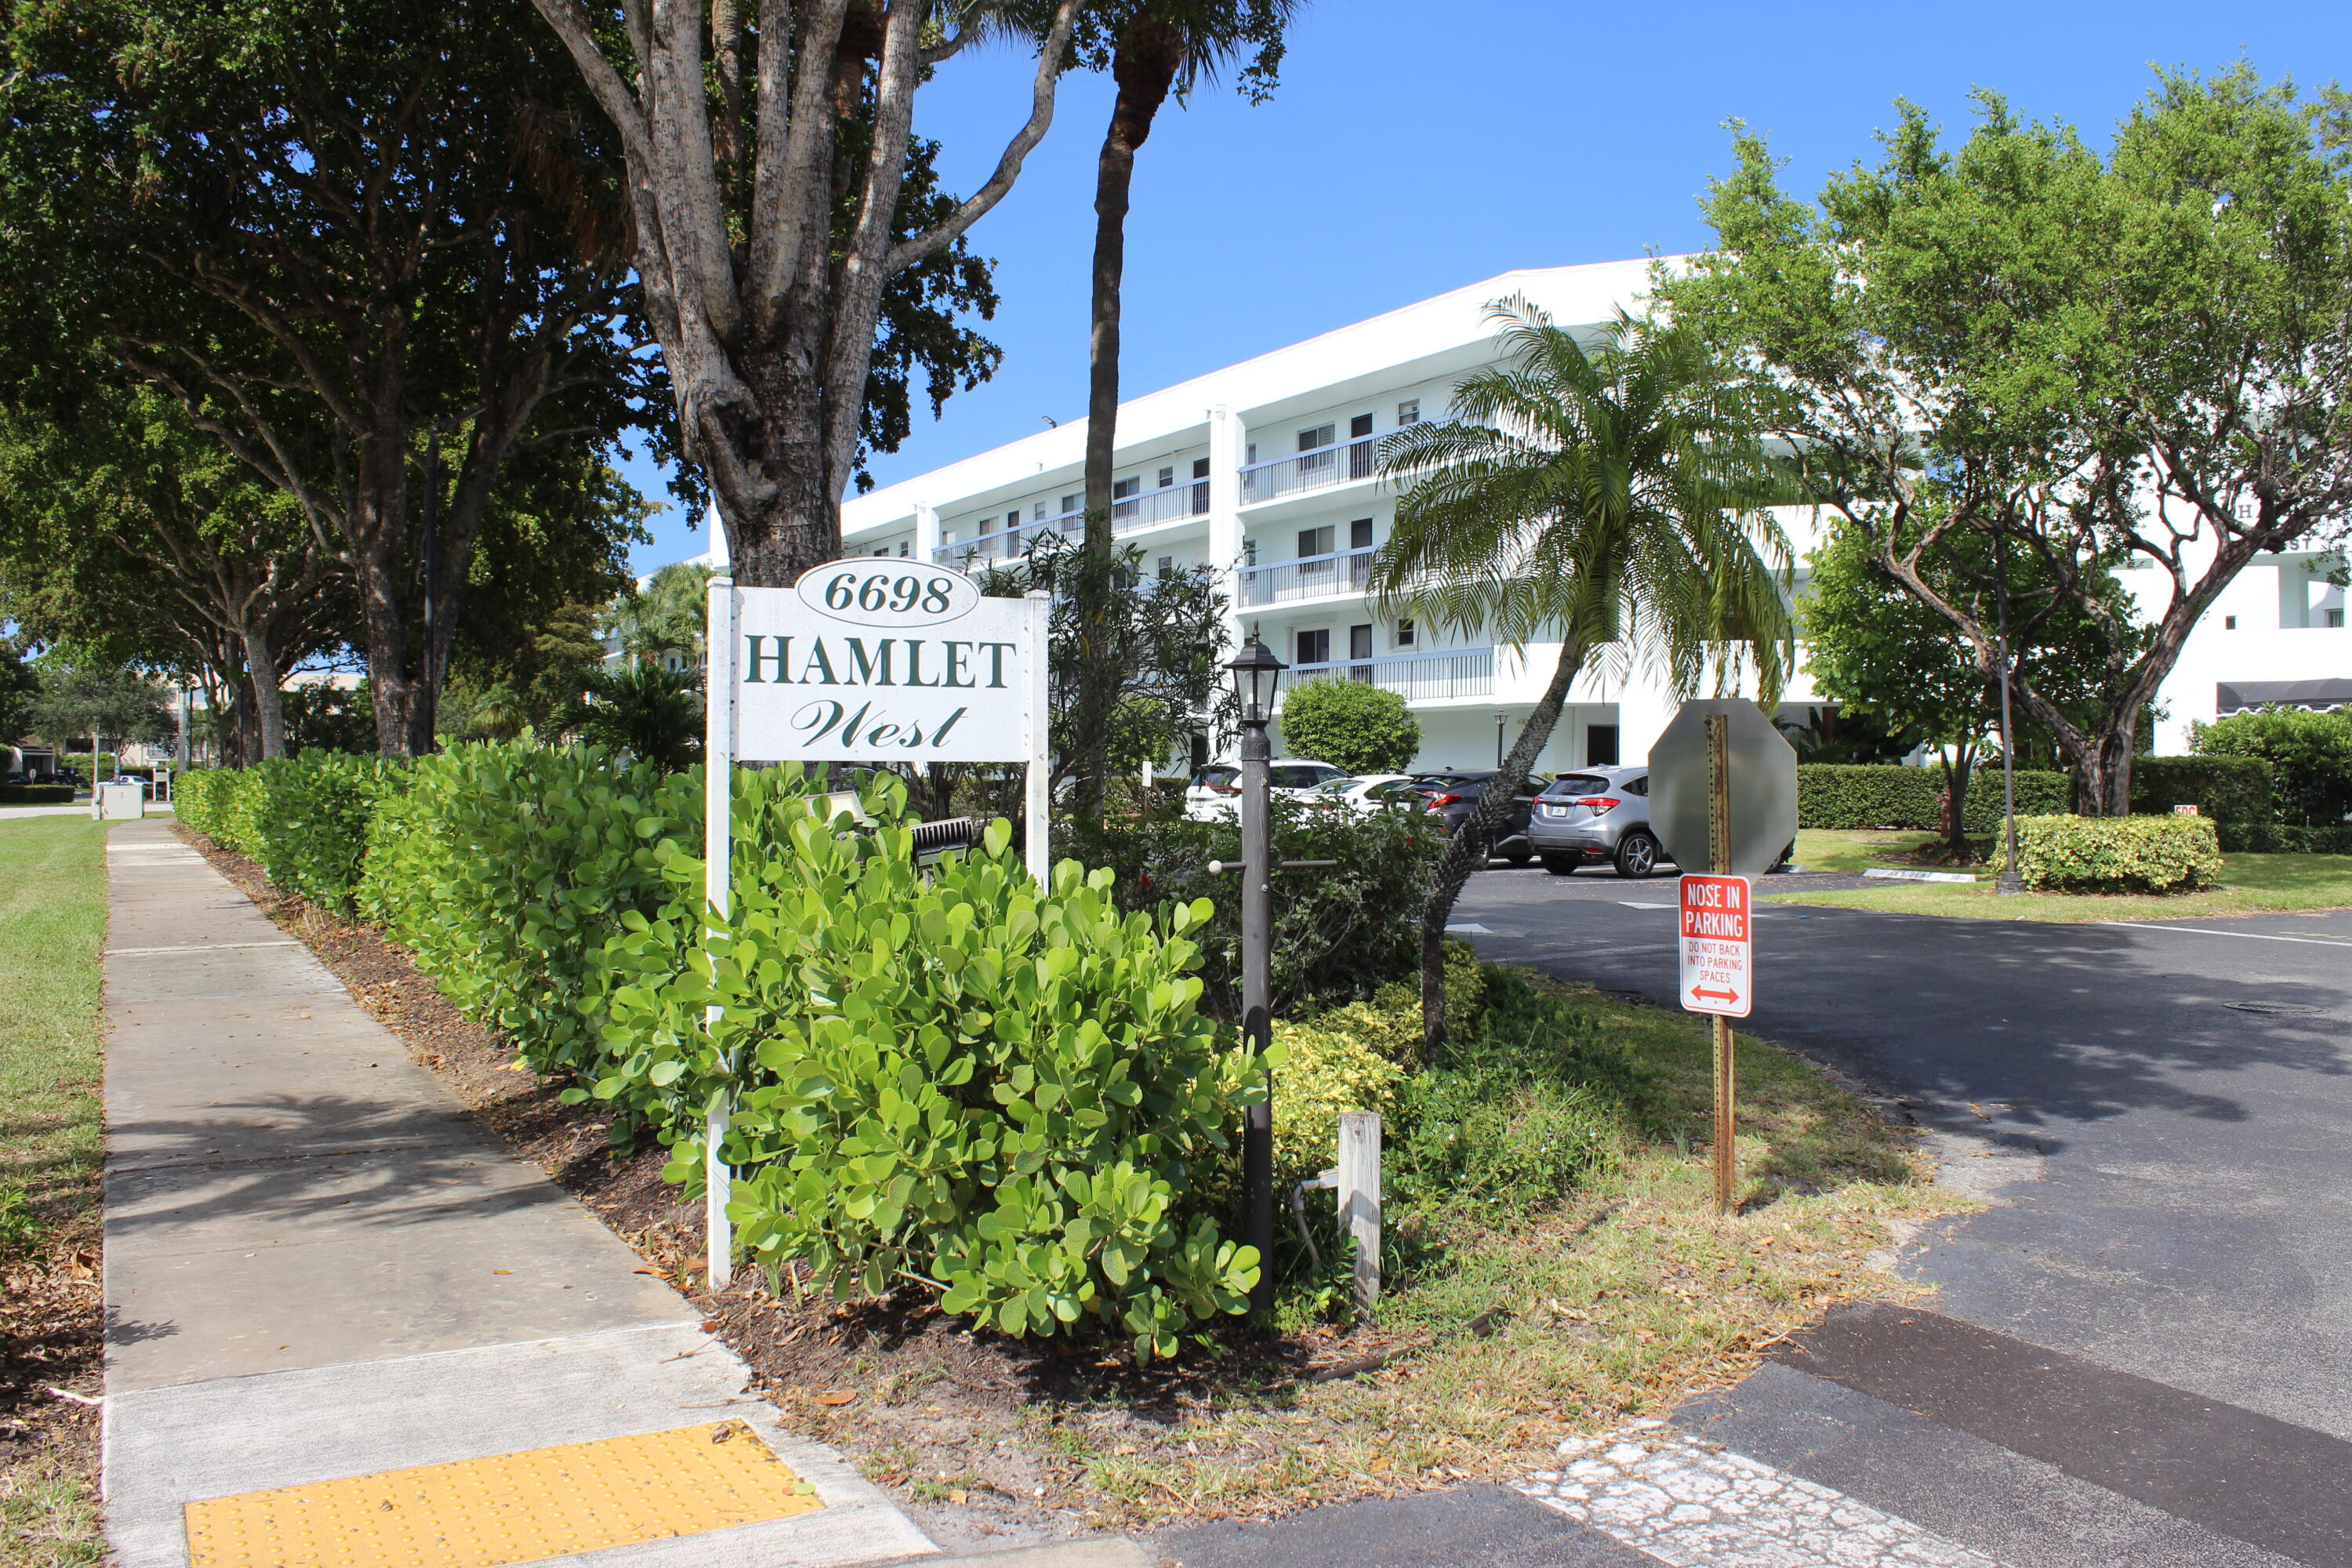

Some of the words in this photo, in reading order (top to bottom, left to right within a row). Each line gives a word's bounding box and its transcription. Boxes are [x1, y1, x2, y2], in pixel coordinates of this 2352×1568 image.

[825, 573, 953, 614] 6698
[743, 634, 1017, 688] HAMLET
[791, 699, 969, 749] West
[1687, 884, 1722, 908] NOSE
[1726, 886, 1740, 909] IN
[1686, 911, 1743, 938] PARKING
[1689, 941, 1699, 953] DO
[1701, 942, 1716, 954] NOT
[1719, 943, 1740, 956] BACK
[1687, 955, 1705, 967] INTO
[1708, 958, 1742, 971] PARKING
[1699, 970, 1730, 983] SPACES
